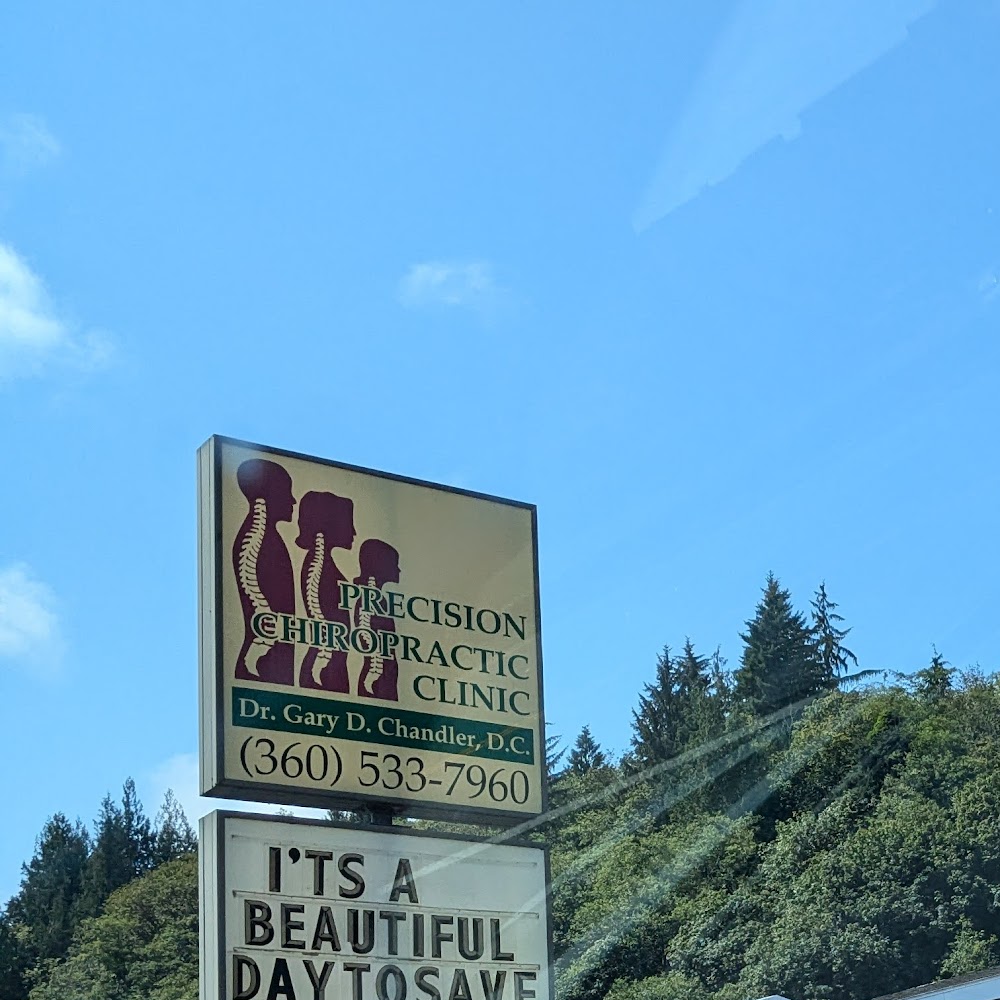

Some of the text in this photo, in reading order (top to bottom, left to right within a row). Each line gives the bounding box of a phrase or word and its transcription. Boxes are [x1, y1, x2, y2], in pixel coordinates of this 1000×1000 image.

[339, 582, 527, 641] PRECISION
[252, 612, 530, 681] CHIROPRACTIC
[413, 675, 531, 717] CLINIC
[238, 698, 530, 756] Dr. Gary D. Chandler, D.C.
[240, 735, 530, 805] (360) 533-7960
[388, 858, 420, 904] A
[244, 899, 515, 962] BEAUTIFUL
